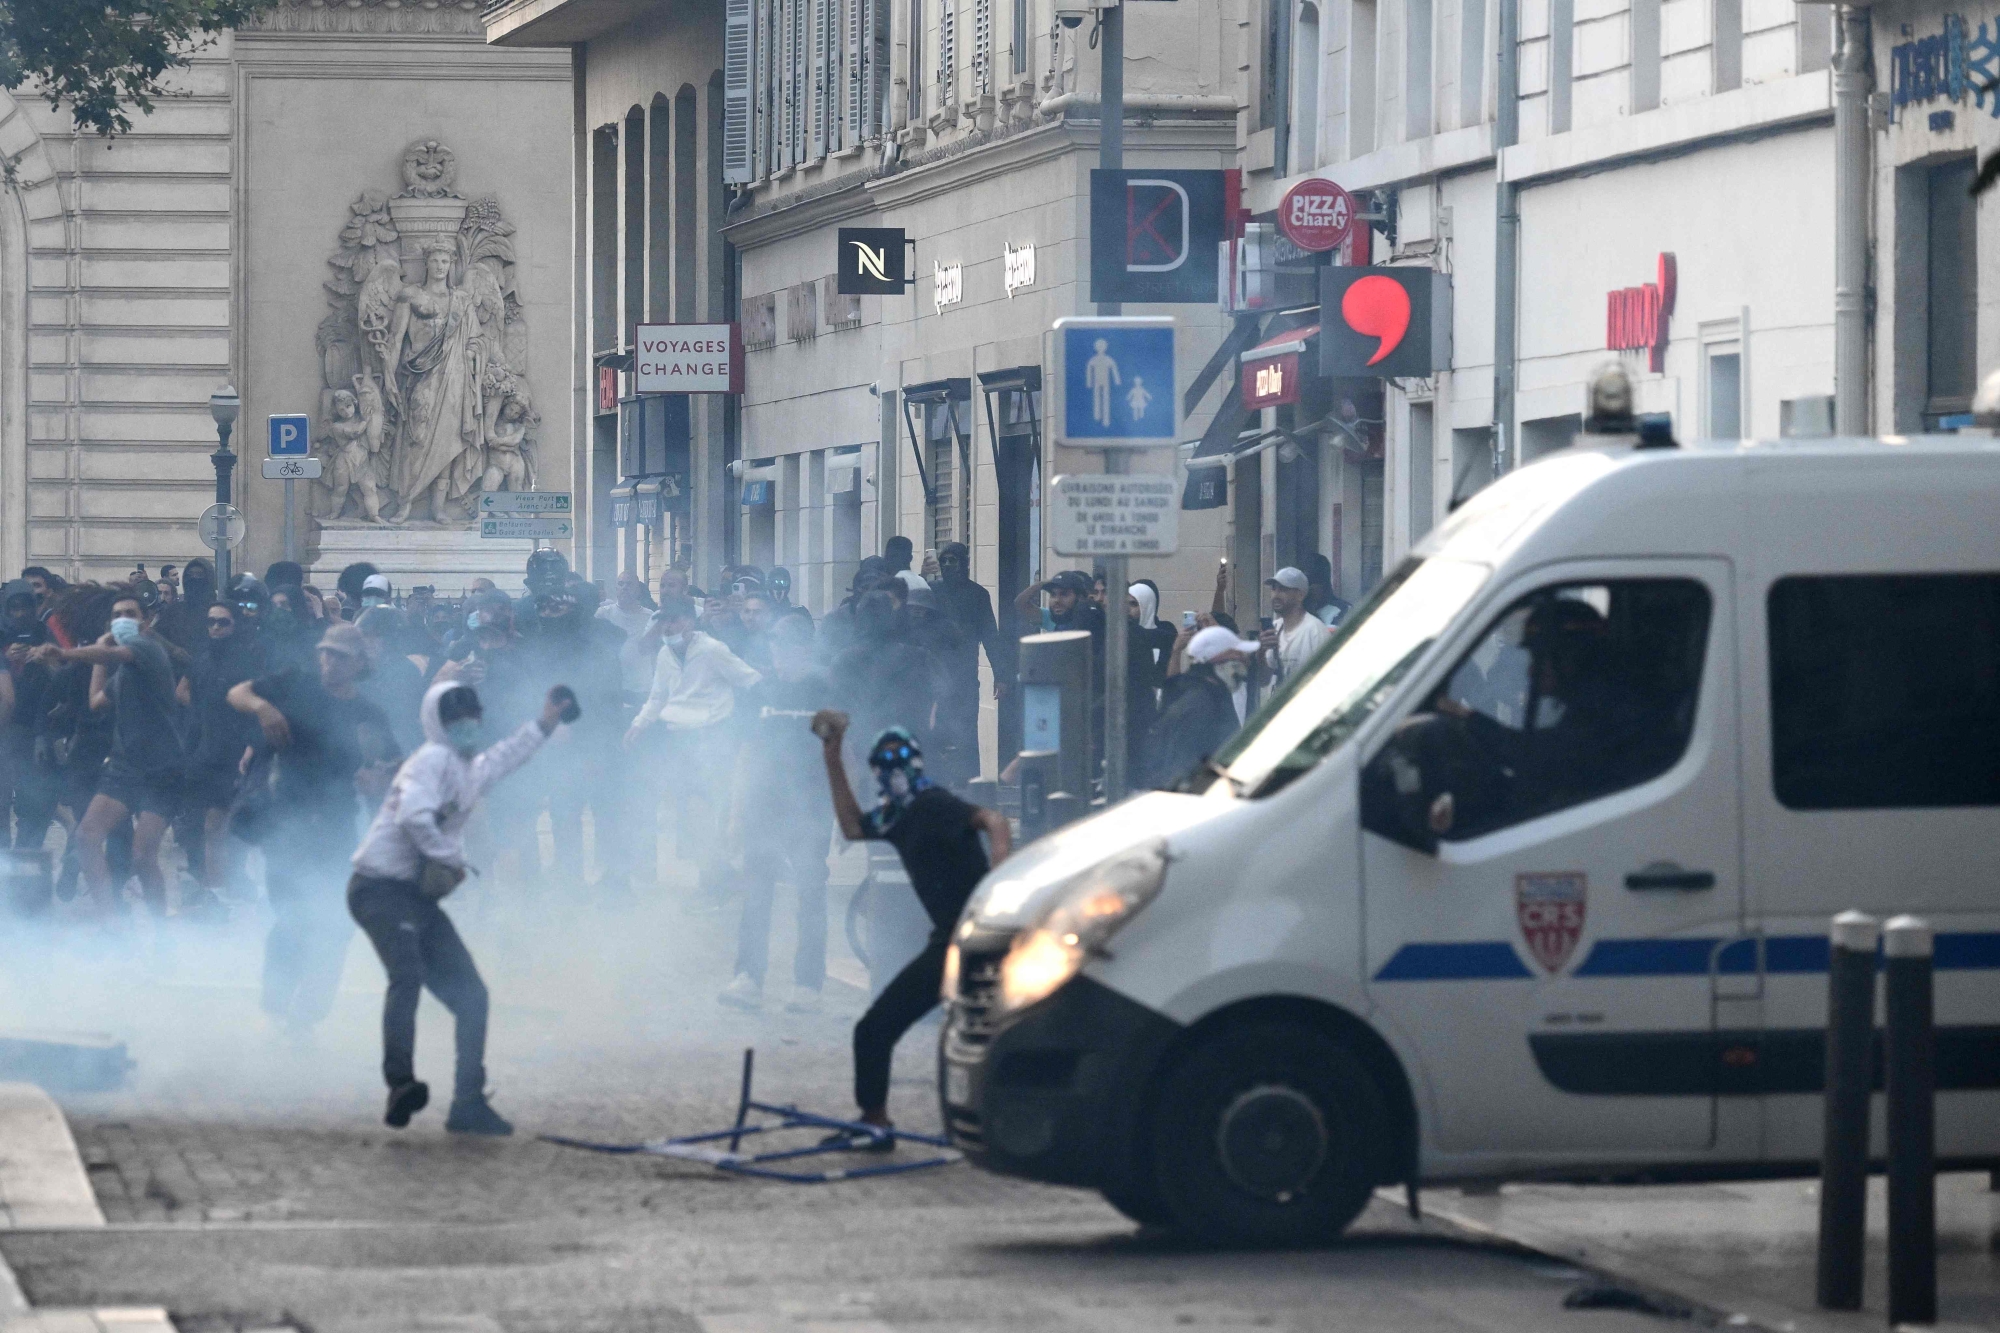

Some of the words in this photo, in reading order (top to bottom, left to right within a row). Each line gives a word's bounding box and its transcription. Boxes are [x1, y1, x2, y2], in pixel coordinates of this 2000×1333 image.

[1292, 195, 1348, 214] PIZZA
[1291, 211, 1348, 230] Charly
[849, 241, 894, 282] N
[643, 340, 726, 353] VOYAGES
[640, 362, 729, 375] CHANGE
[280, 424, 298, 448] P
[1067, 496, 1081, 507] DU
[1085, 496, 1113, 507] LUNDI
[1117, 496, 1130, 507] AU
[1134, 496, 1169, 507] SAMEDI
[1523, 904, 1580, 928] CRS
